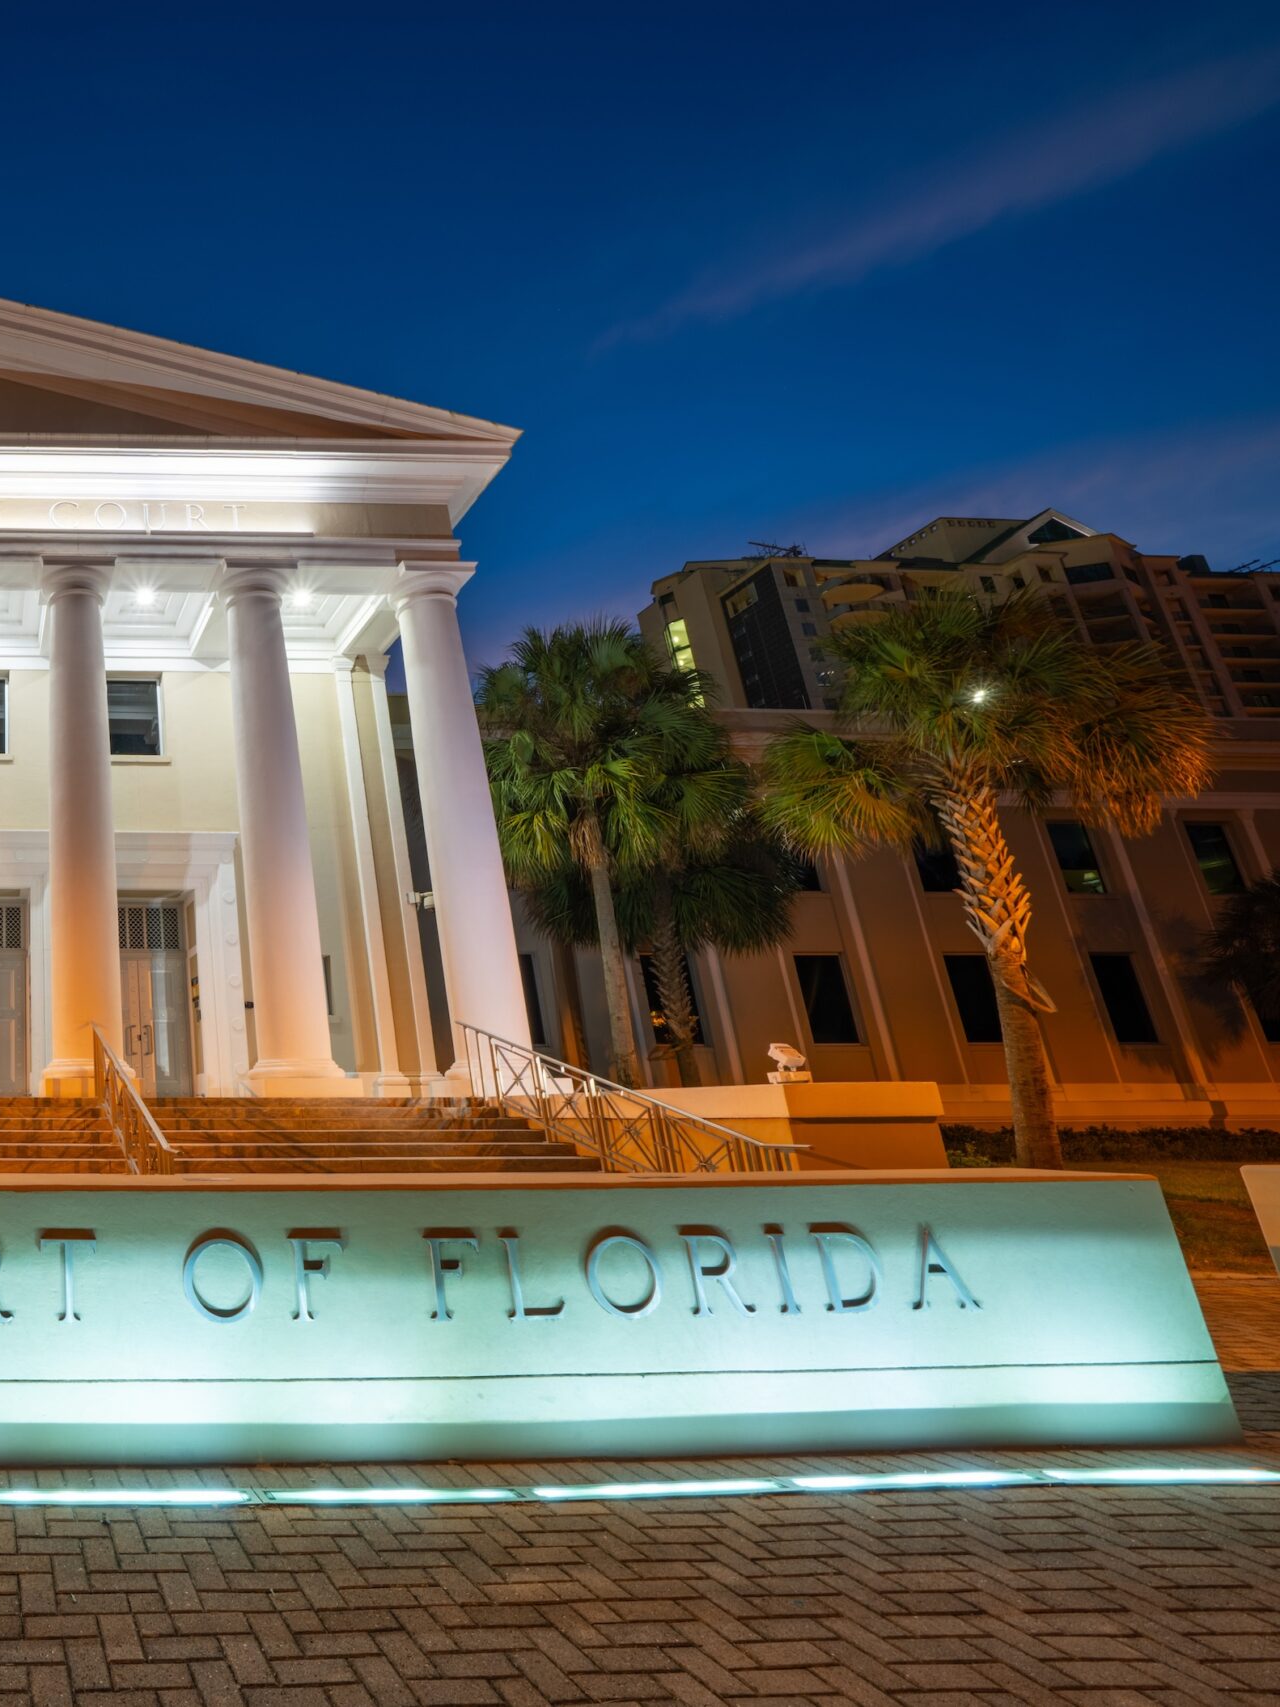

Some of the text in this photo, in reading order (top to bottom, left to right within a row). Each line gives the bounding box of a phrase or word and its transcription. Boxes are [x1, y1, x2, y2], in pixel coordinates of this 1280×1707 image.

[48, 501, 247, 531] COURT
[182, 1226, 346, 1324] OF
[421, 1222, 982, 1321] FLORIDA
